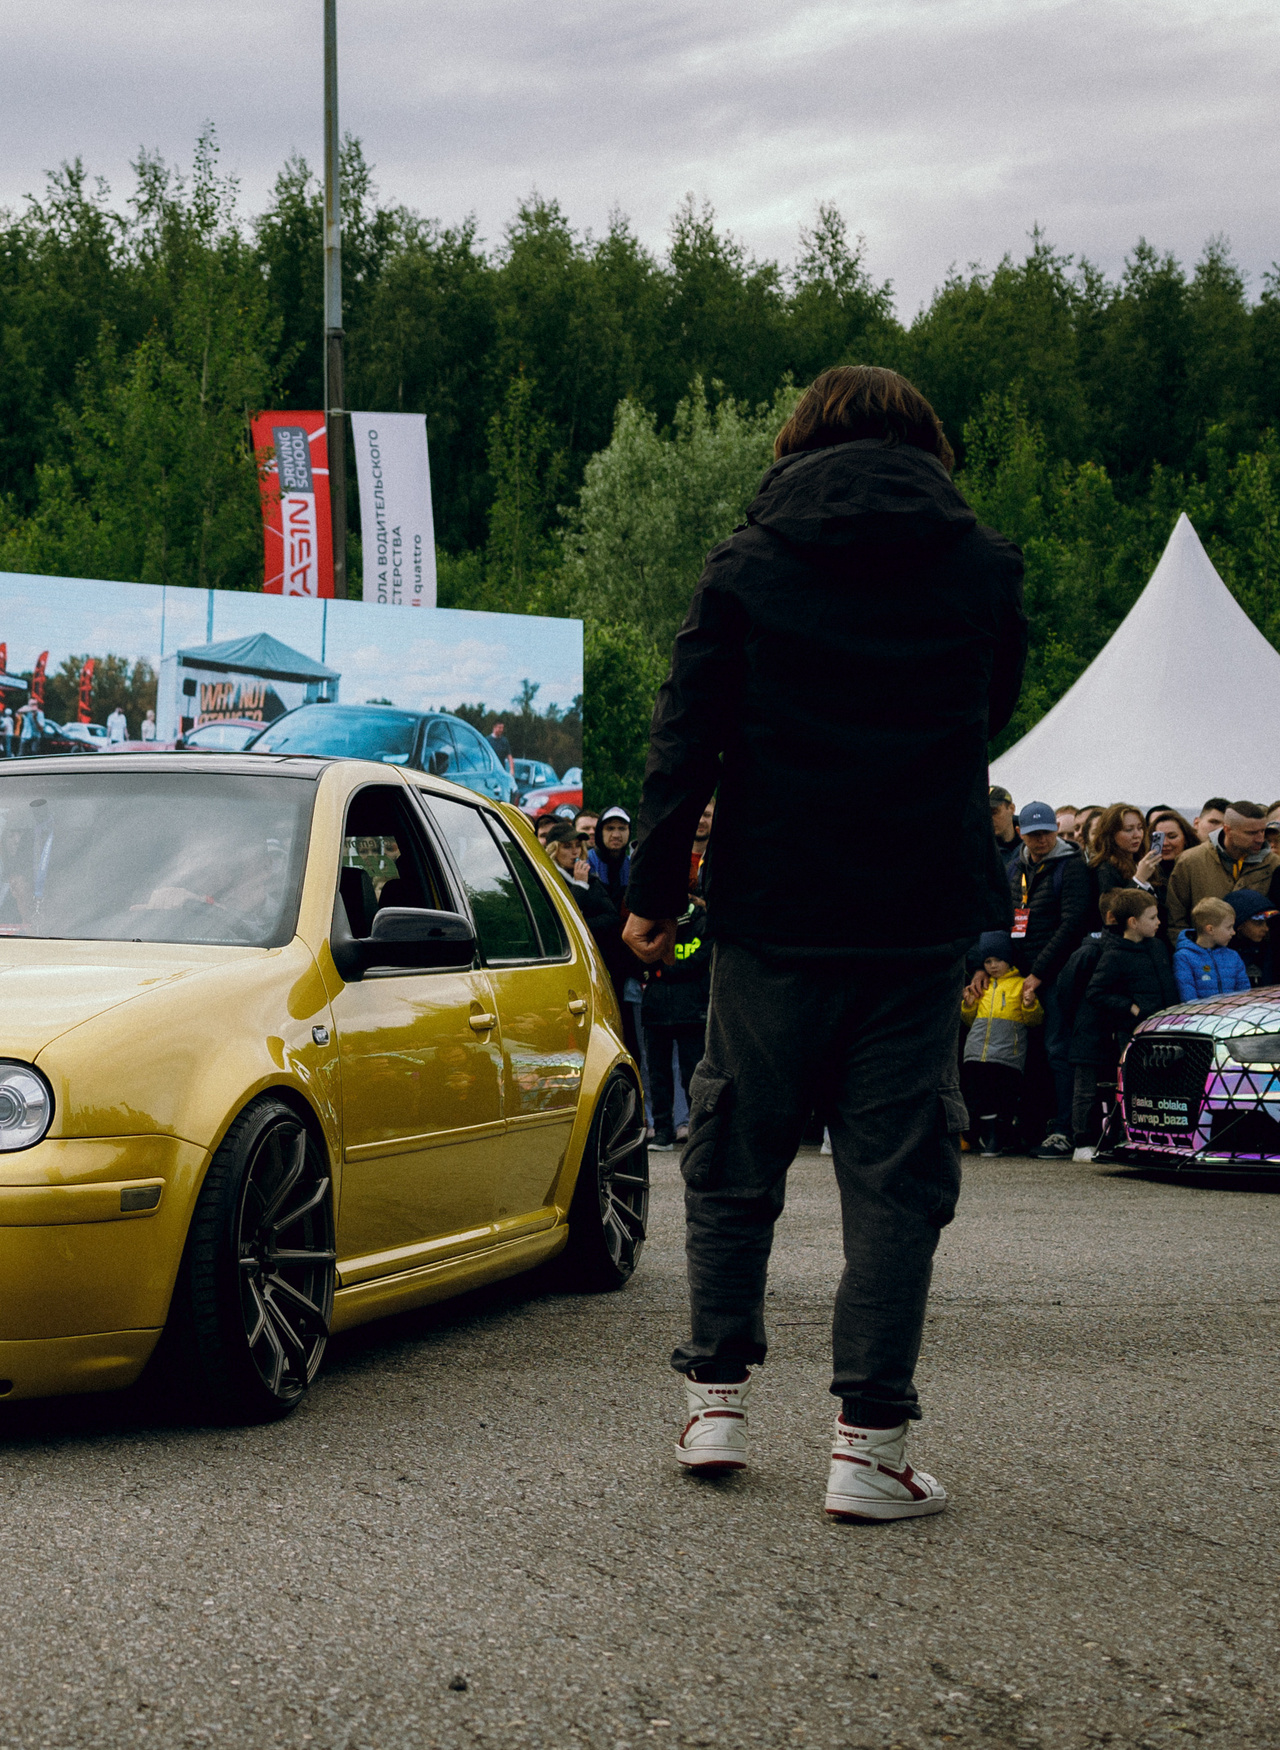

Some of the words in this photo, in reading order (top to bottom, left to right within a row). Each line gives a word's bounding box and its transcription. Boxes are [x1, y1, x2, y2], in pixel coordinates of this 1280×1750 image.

[278, 431, 297, 488] DRIVING
[292, 431, 309, 488] SCHOOL
[368, 429, 388, 566] ВОДИТЕЛЬСКОГО
[413, 534, 424, 594] quattro
